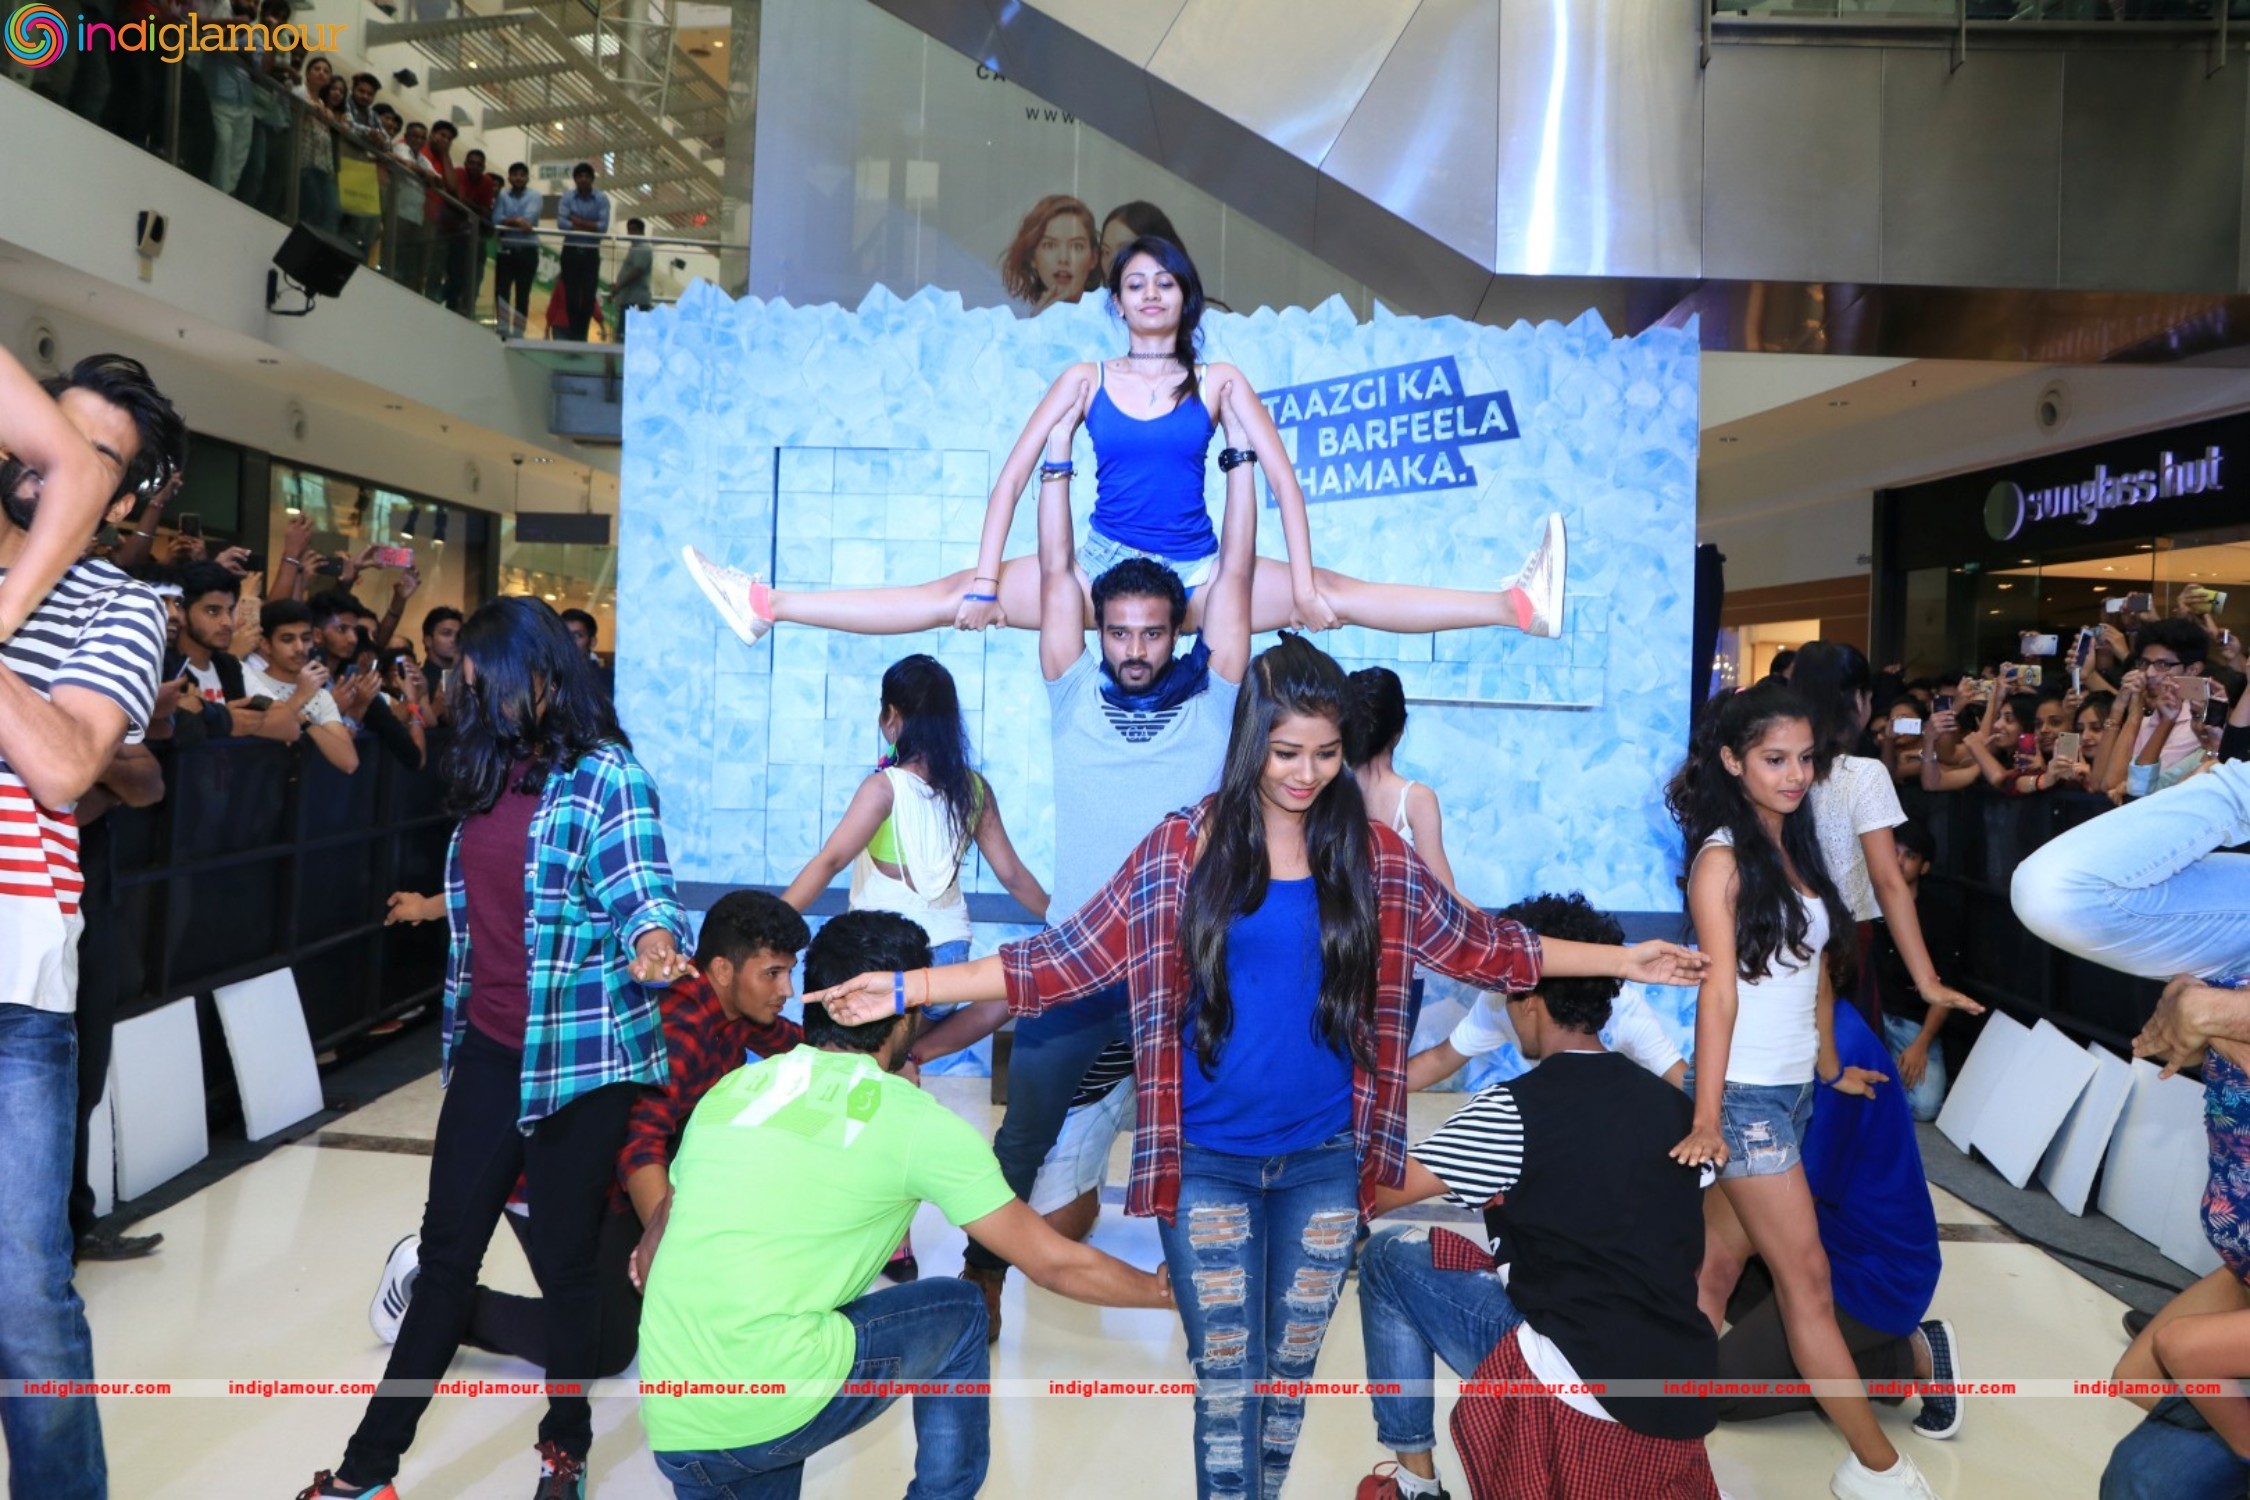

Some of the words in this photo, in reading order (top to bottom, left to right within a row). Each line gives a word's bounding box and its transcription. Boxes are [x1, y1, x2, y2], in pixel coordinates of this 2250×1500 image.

[1261, 376, 1387, 425] TAAZGI
[1398, 365, 1454, 404] KA
[1317, 400, 1510, 458] BARFEELA
[1293, 452, 1467, 497] HAMAKA.
[2027, 464, 2157, 526] sunglass
[2160, 445, 2224, 498] hut
